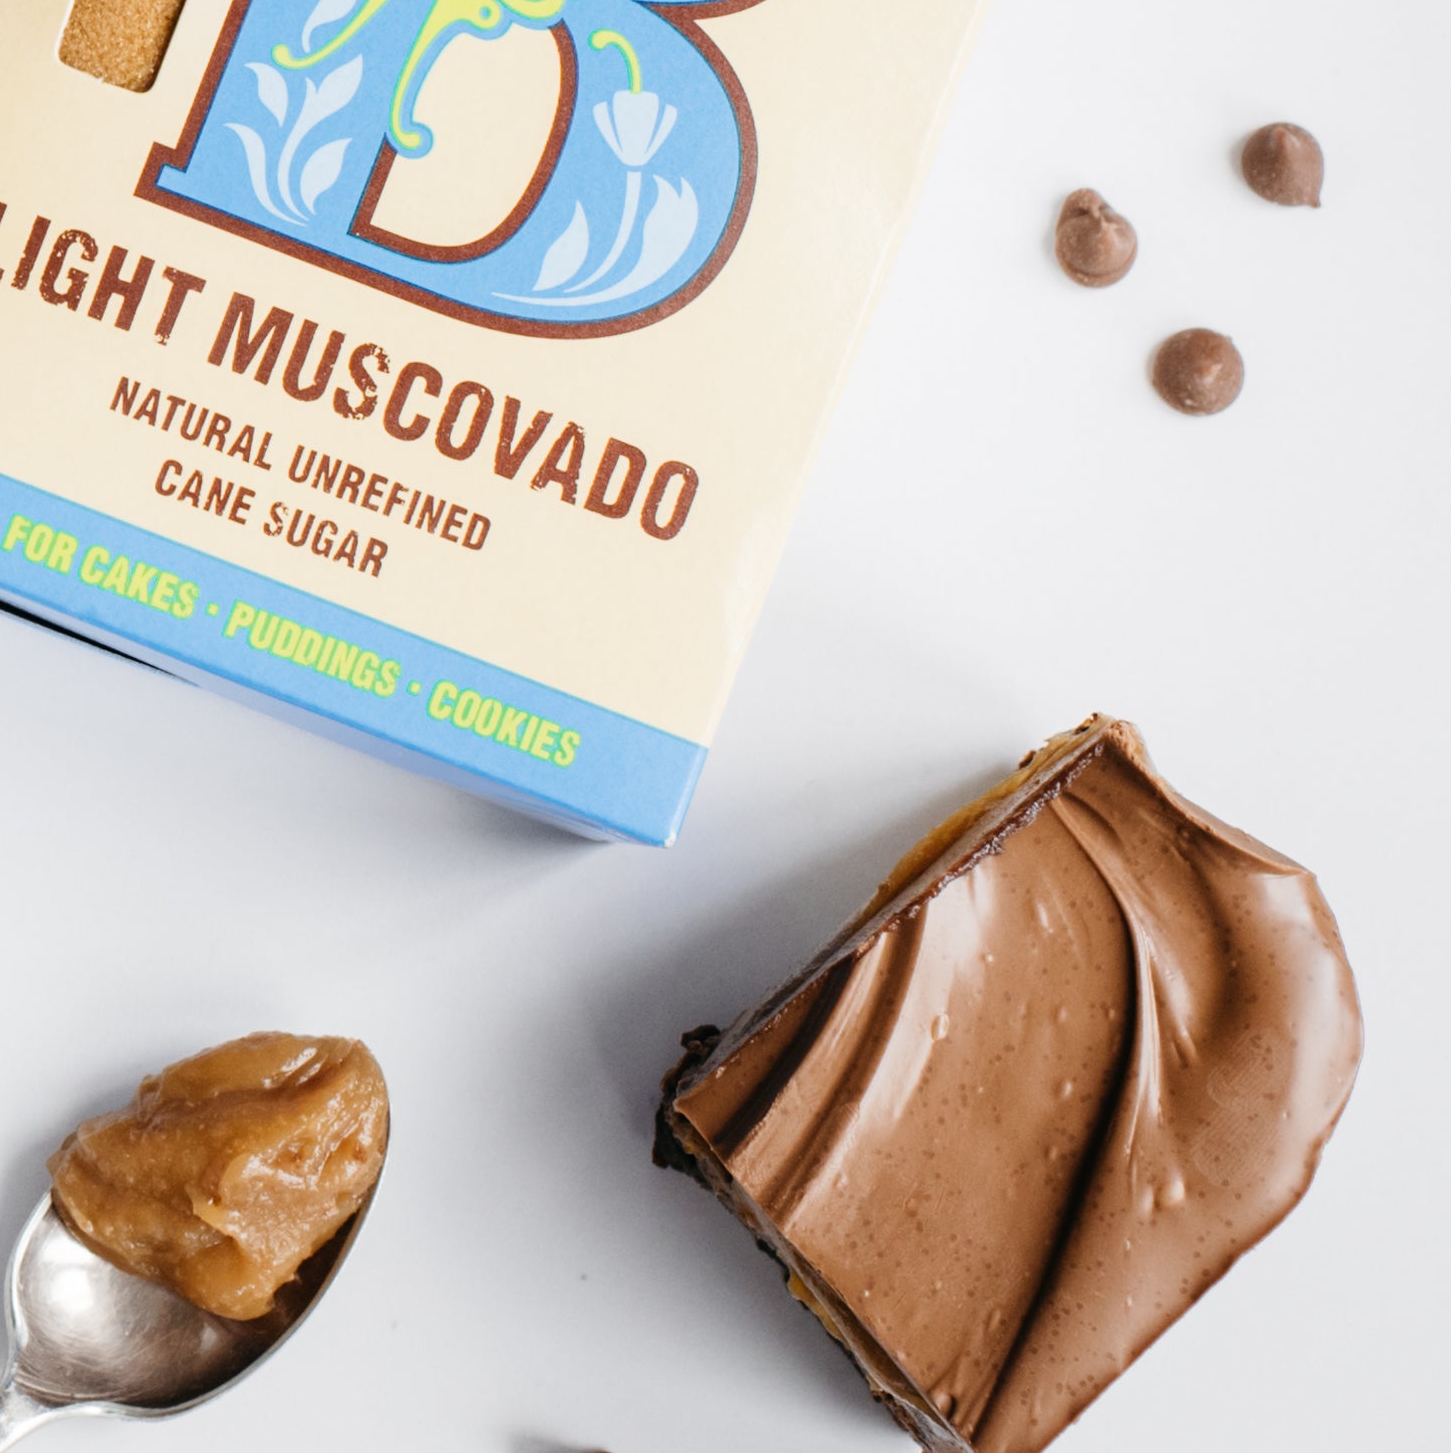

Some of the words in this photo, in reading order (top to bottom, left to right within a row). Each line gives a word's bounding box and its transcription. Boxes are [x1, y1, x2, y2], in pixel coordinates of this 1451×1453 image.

[112, 378, 270, 470] NATURAL
[290, 446, 490, 549] UNREFINED
[155, 459, 257, 526] CANE
[262, 499, 388, 577] SUGAR
[209, 293, 698, 540] MUSCOVADO
[1, 514, 78, 574] FOR
[79, 545, 199, 619] CAKES
[224, 600, 401, 697] PUDDINGS
[427, 681, 580, 767] COOKIES
